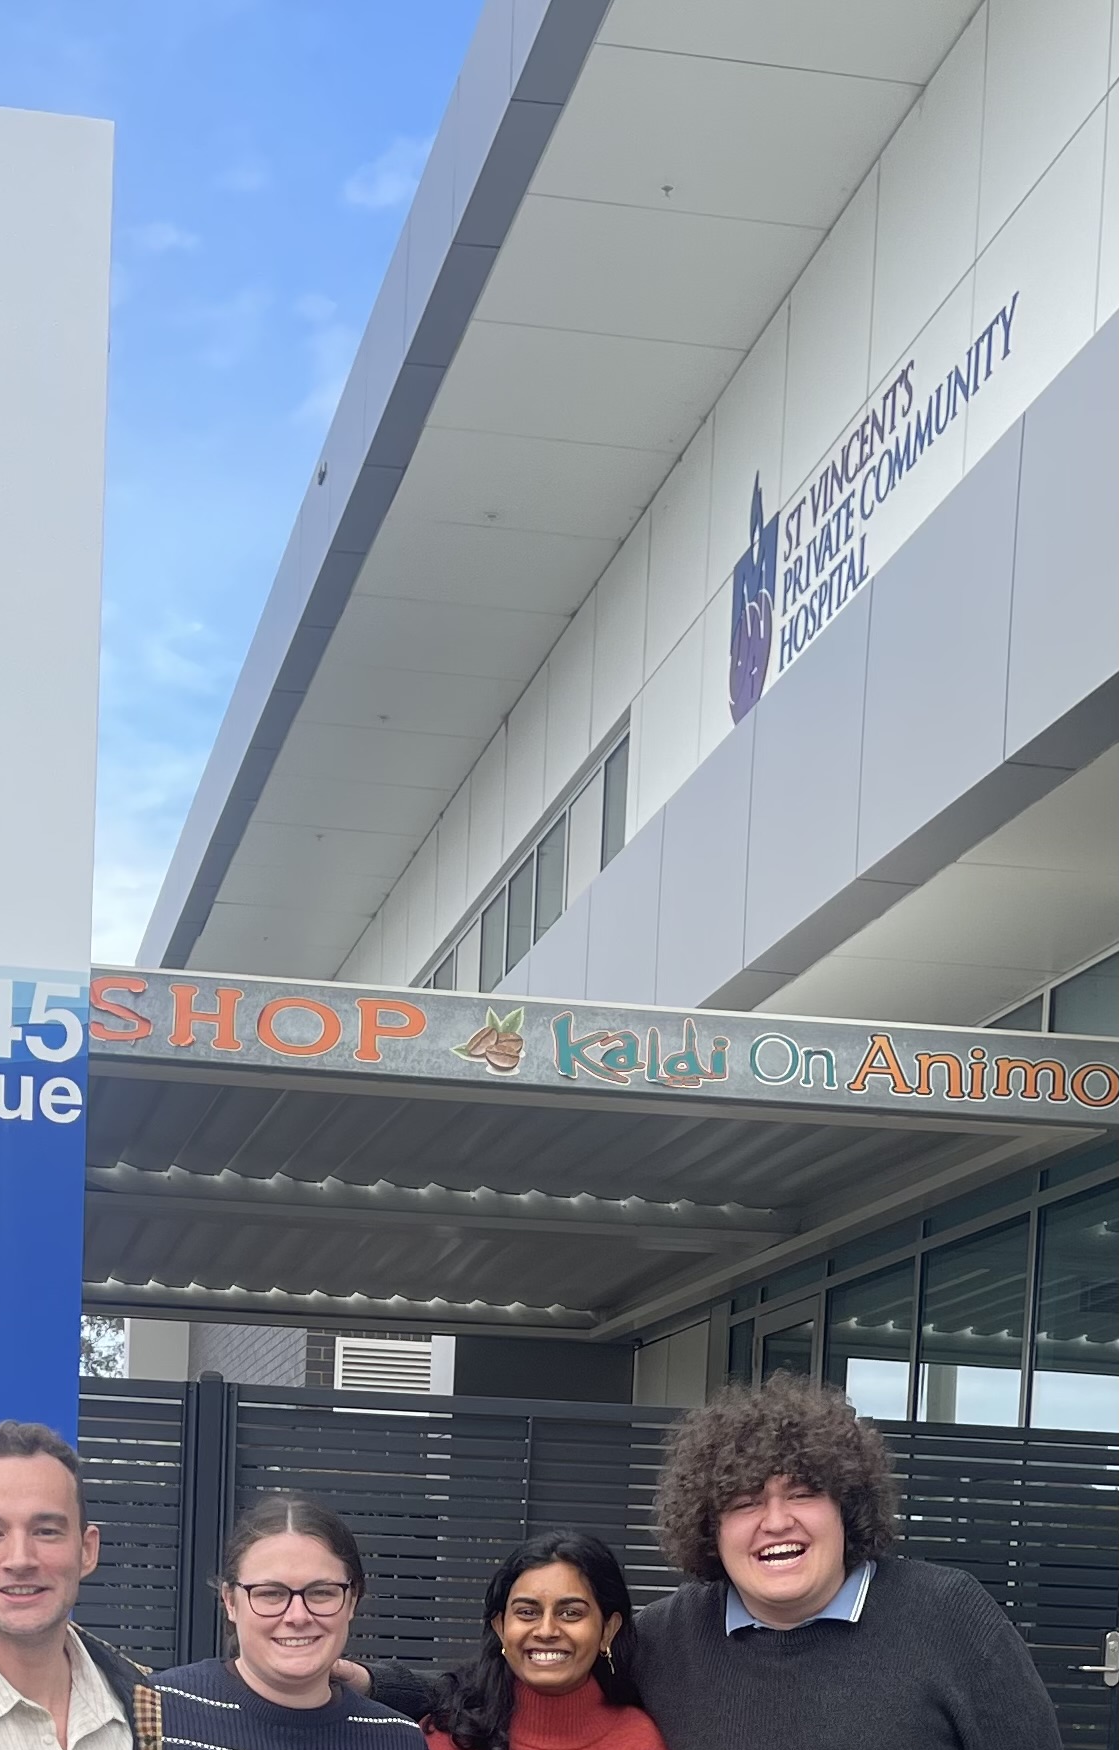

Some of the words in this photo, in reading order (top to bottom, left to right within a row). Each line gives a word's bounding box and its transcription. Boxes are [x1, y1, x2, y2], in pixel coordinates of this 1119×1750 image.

[781, 488, 856, 617] PRIVATE
[859, 291, 1020, 521] COMMUNITY
[783, 495, 807, 563] ST
[809, 359, 915, 528] VINCENT'S
[778, 532, 870, 673] HOSPITAL
[89, 975, 428, 1063] SHOP
[749, 1032, 838, 1091] On
